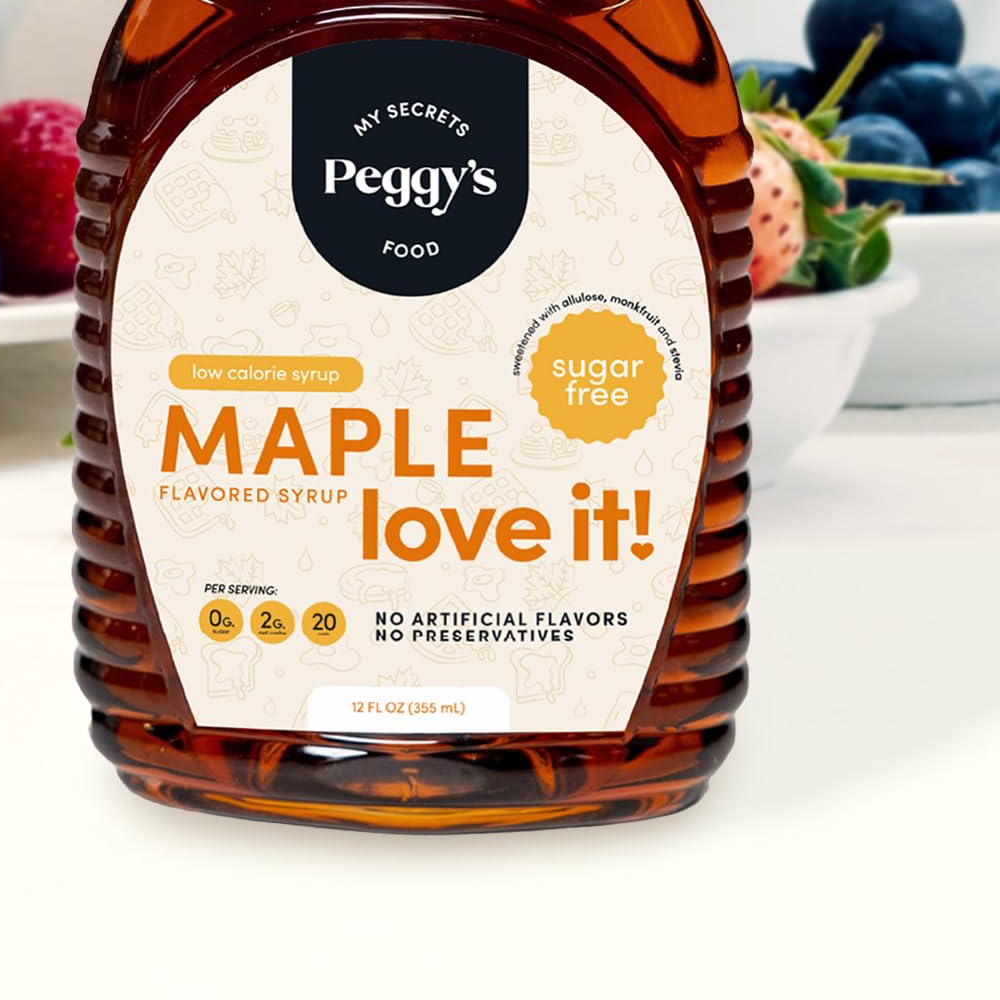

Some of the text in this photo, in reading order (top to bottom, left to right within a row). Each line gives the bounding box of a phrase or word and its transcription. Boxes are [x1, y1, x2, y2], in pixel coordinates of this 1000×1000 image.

[353, 102, 470, 137] MY SECRETS
[324, 158, 498, 217] Peggy's
[382, 239, 440, 259] FOOD
[513, 292, 685, 381] sweetened with allulose, monkfruit and stevia
[192, 364, 341, 385] low calorie syrup
[552, 358, 644, 386] sugar
[565, 379, 630, 406] free
[160, 404, 494, 478] MAPLE
[159, 485, 348, 504] FLAVORED SYRUP
[362, 482, 655, 563] love it!
[204, 583, 278, 596] PER SERVING:
[312, 613, 337, 632] 20
[375, 612, 628, 626] NO ARTIFICIAL FLAVORS
[375, 629, 574, 642] NO PRESERVATIVES
[351, 701, 466, 716] 12 FL OZ (355 mL)
